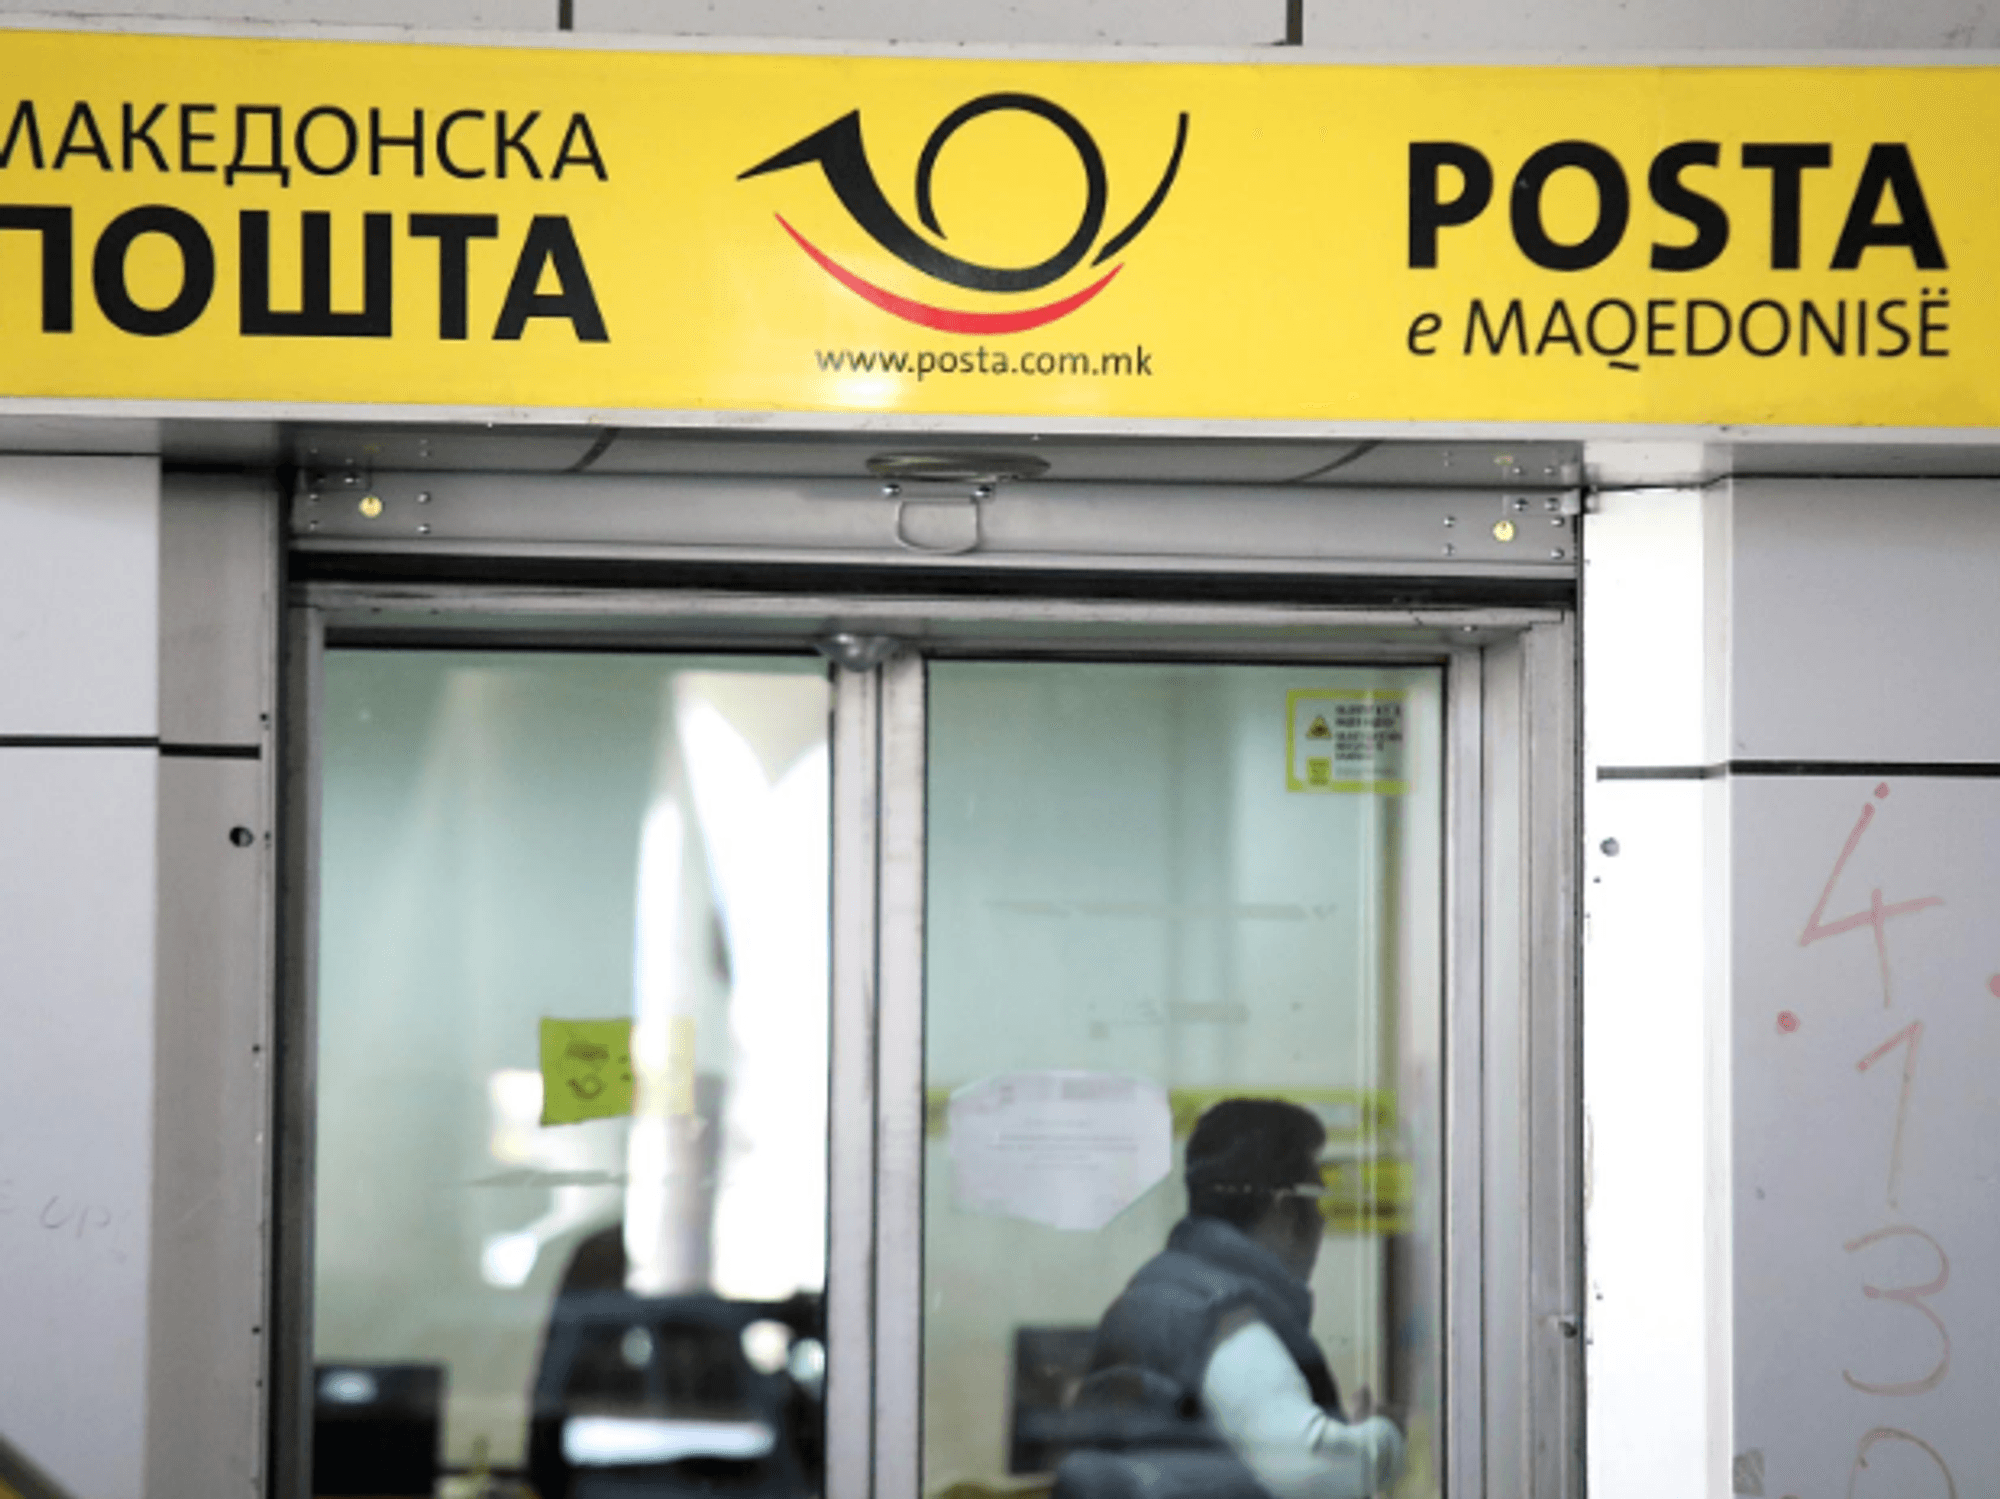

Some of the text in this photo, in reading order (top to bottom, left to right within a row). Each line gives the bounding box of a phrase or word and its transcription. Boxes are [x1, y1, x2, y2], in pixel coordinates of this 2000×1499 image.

[0, 99, 608, 188] МАКЕДОНСКА
[1408, 140, 1949, 272] POSTA
[0, 204, 610, 343] ПОШТА
[815, 345, 1152, 381] www.posta.com.mk
[1407, 287, 1950, 371] e MAQEDONISË
